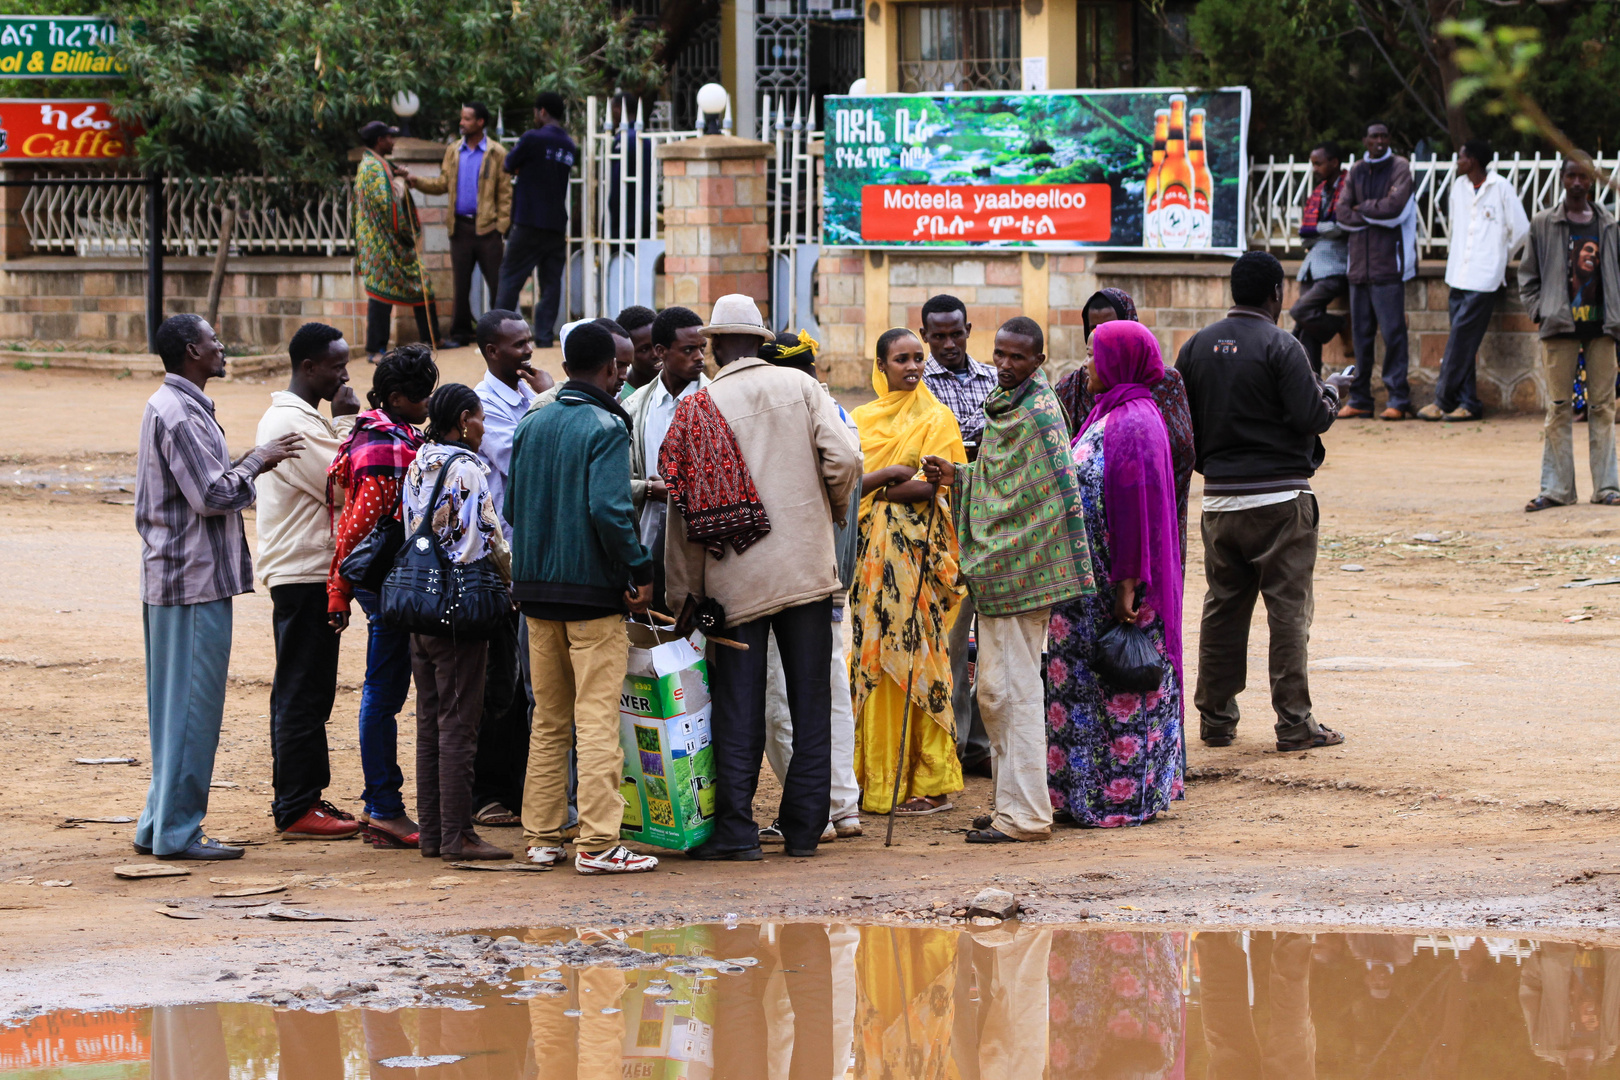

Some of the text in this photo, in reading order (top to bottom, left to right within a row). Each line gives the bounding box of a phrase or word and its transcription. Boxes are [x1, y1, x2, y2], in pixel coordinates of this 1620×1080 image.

[0, 21, 116, 47] ልና ከረን
[0, 51, 24, 73] ol
[27, 51, 44, 73] &
[40, 104, 112, 130] ካፌ
[22, 130, 122, 158] Caffe
[884, 189, 1086, 214] Moteela yaabeelloo
[913, 215, 1056, 236] ያቤሎ ሞቴል
